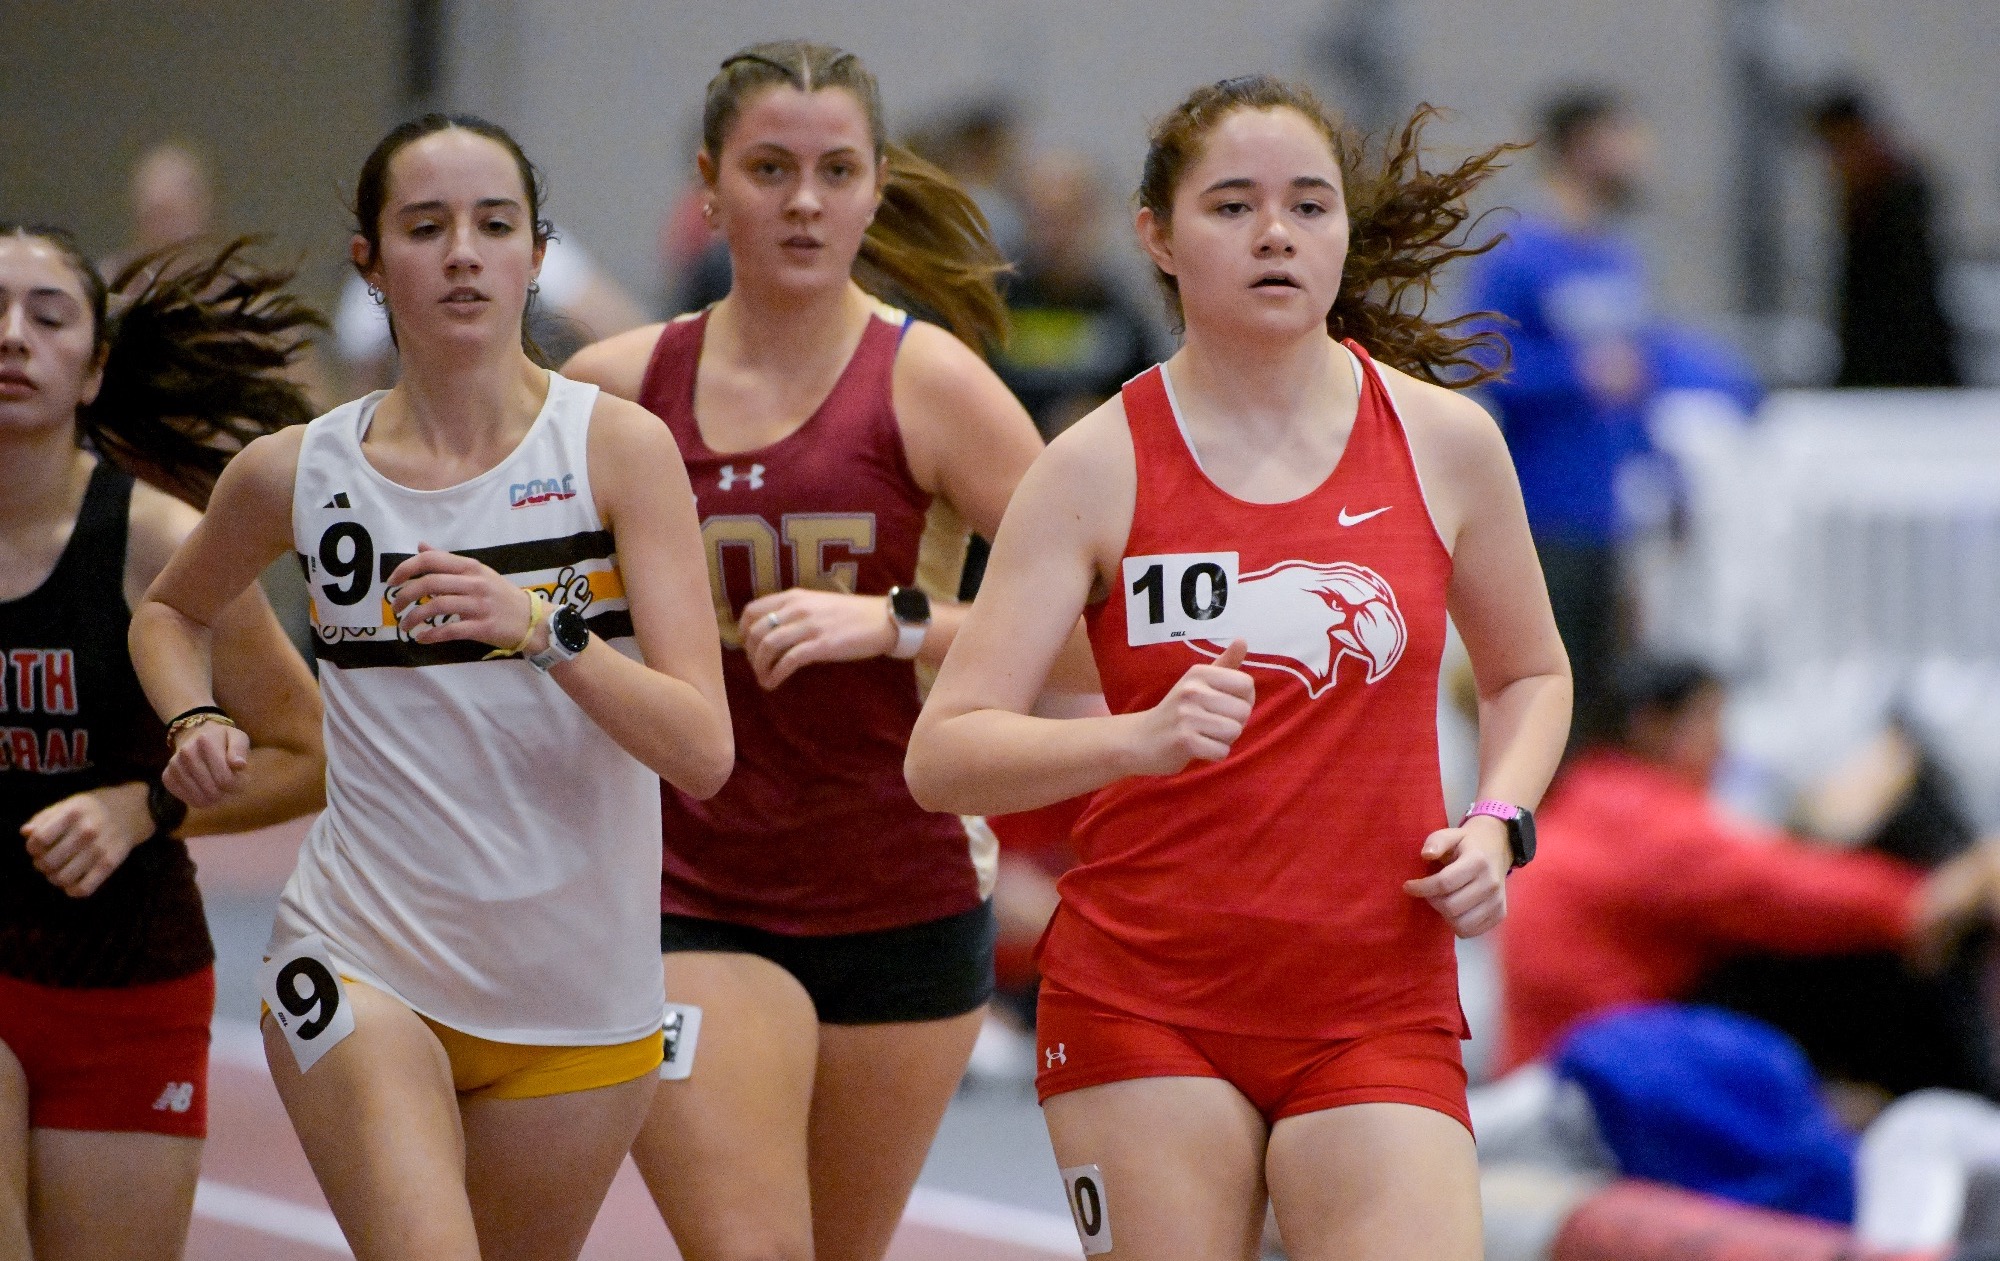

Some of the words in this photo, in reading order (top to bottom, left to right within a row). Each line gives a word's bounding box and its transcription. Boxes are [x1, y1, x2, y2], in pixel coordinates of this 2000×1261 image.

[319, 521, 374, 606] 9
[1132, 562, 1228, 625] 10
[276, 956, 340, 1041] 9
[1065, 1177, 1101, 1236] 0
